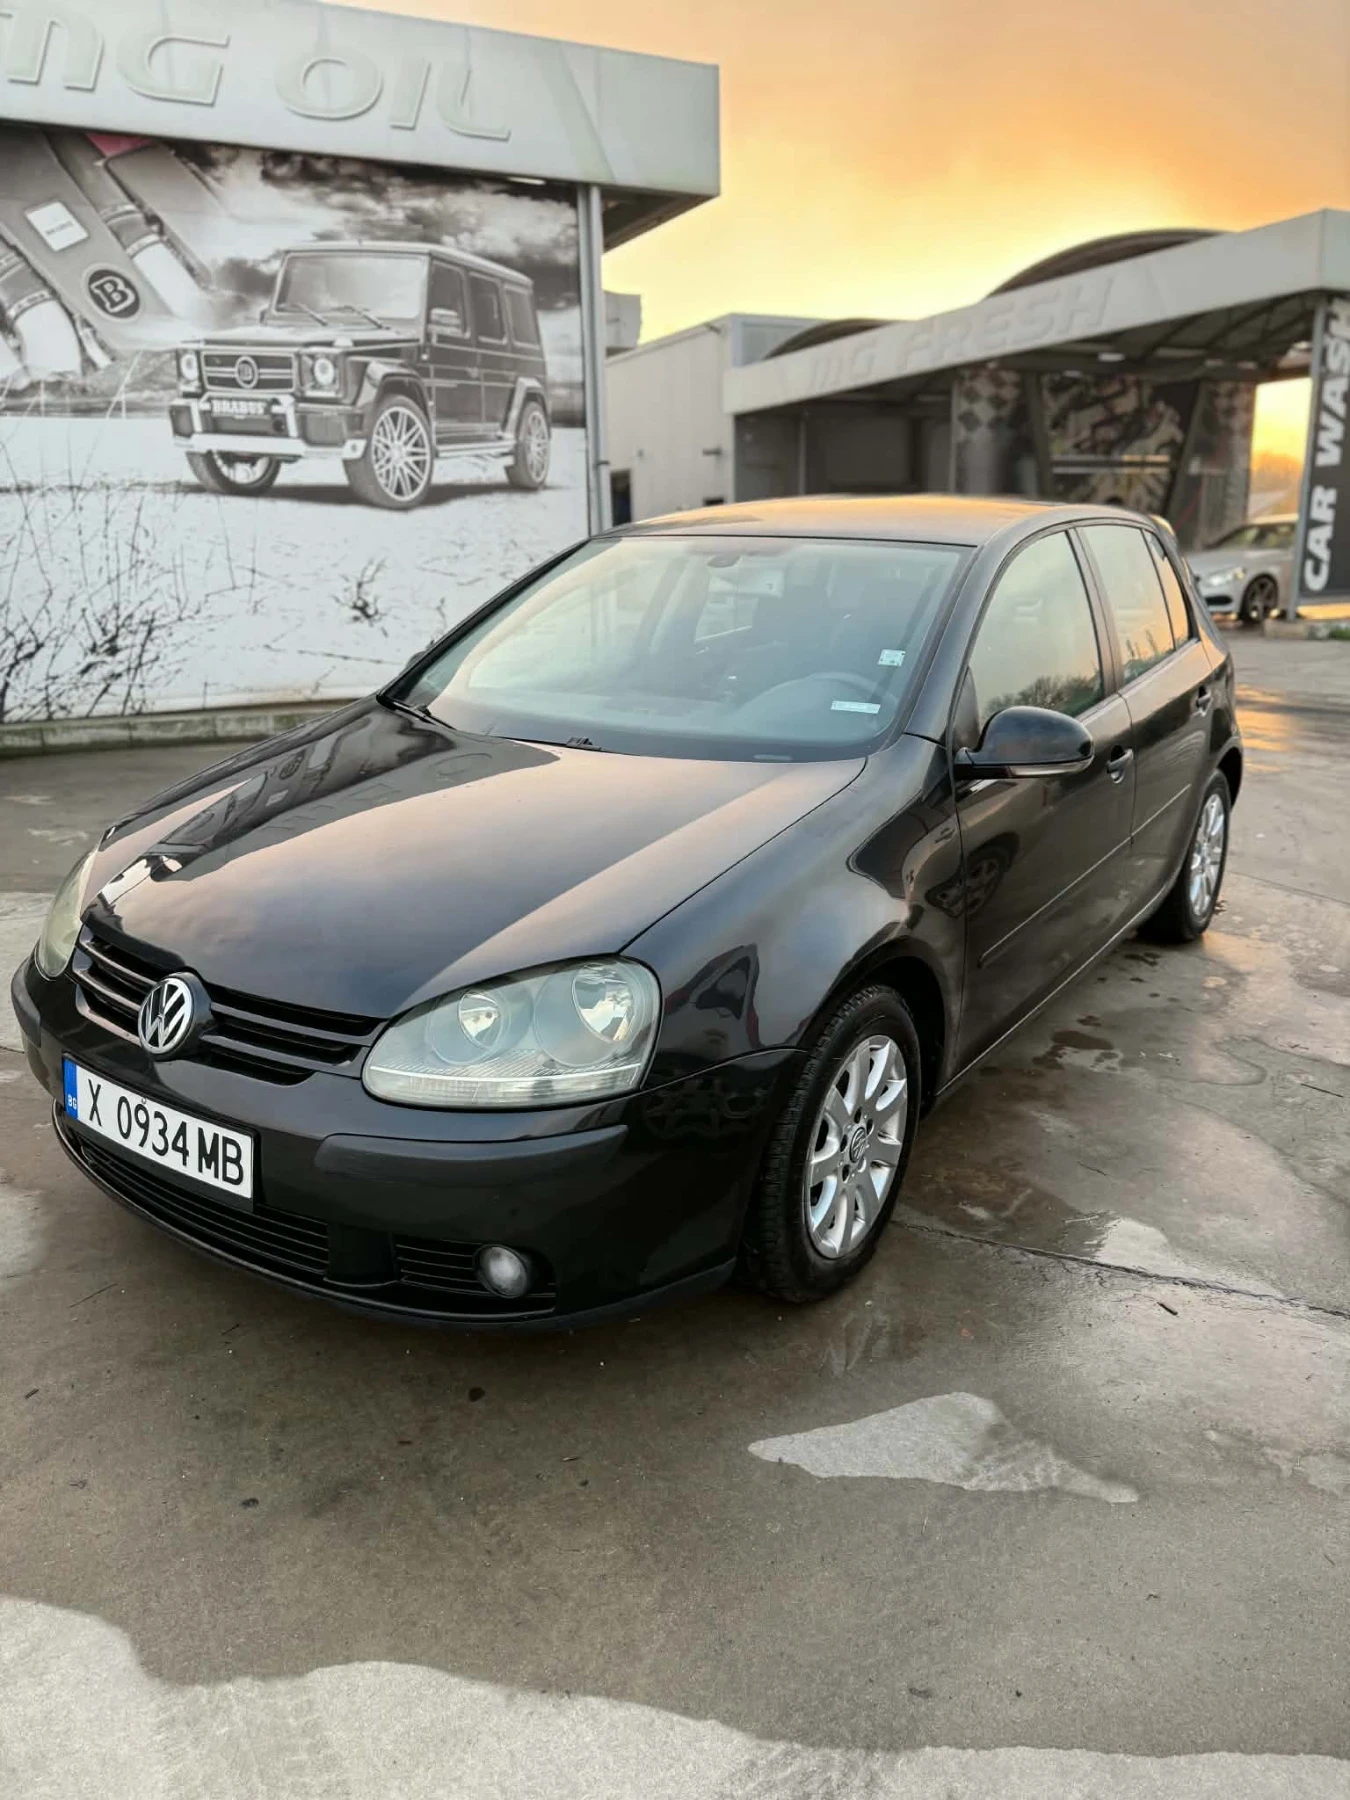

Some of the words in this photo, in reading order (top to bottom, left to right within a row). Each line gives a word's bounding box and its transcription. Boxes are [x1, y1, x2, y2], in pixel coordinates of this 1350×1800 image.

[274, 45, 512, 142] OIL
[90, 275, 135, 312] B
[895, 276, 1114, 372] FRESH
[1315, 297, 1350, 467] WASH
[1304, 485, 1337, 591] CAR
[68, 1094, 77, 1109] BG
[88, 1078, 102, 1127] X
[117, 1095, 189, 1167] 0934
[197, 1126, 244, 1186] MB
